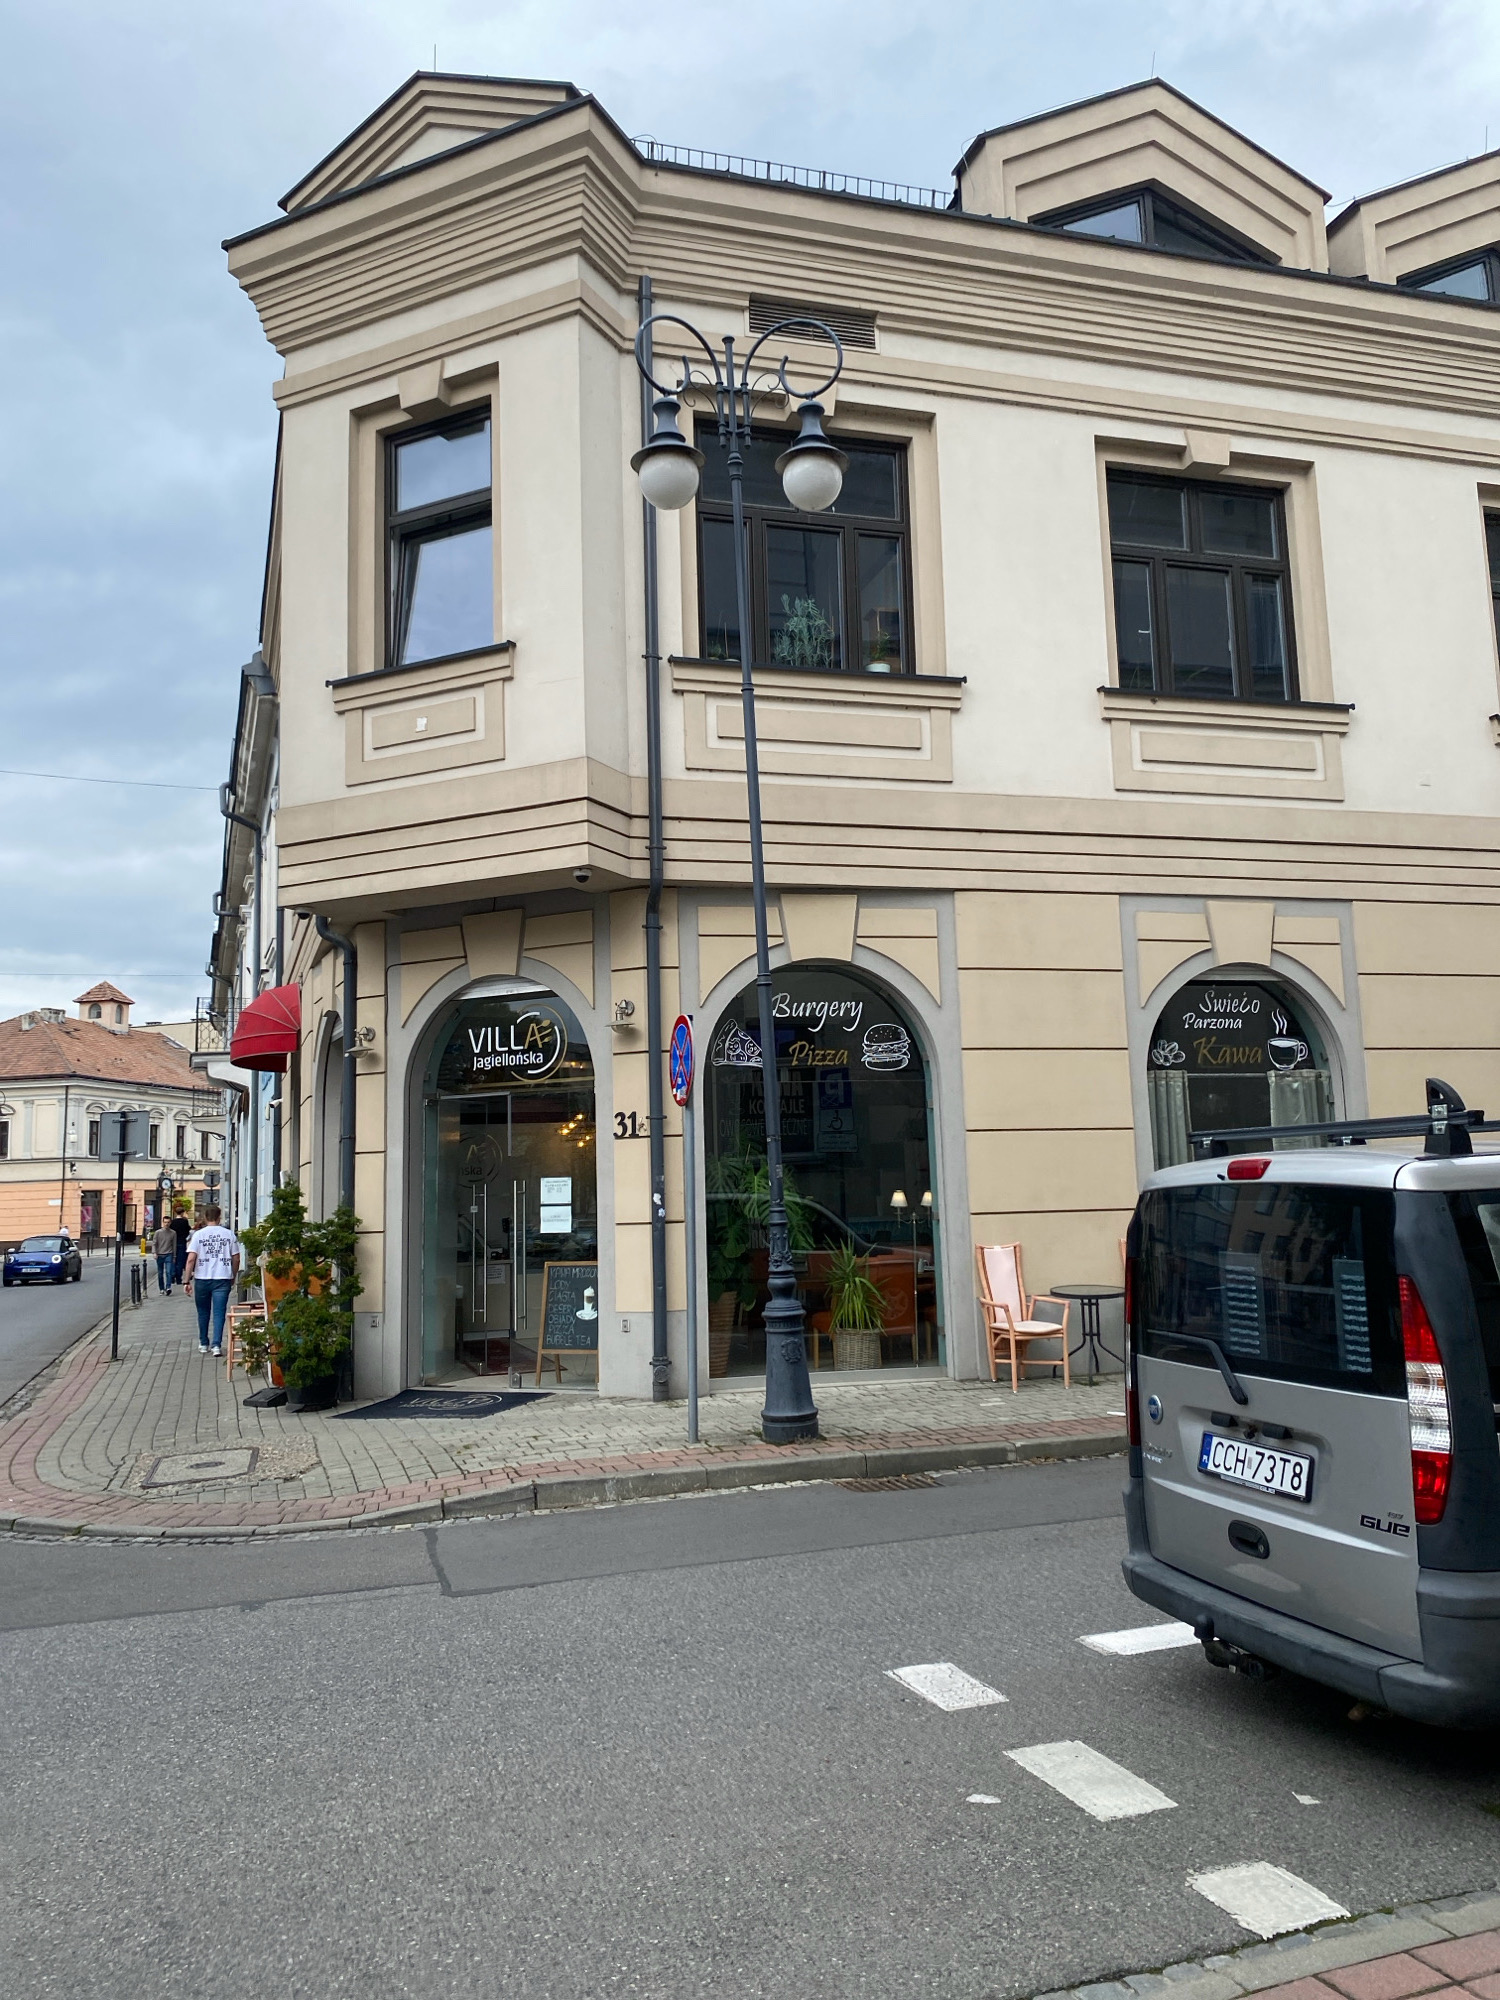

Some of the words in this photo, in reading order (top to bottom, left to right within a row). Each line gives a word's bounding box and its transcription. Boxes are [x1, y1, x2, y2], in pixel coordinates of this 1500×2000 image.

[772, 992, 863, 1032] Burgery
[1182, 1012, 1243, 1030] Parzona
[468, 1023, 546, 1054] VILLA
[1193, 1036, 1263, 1065] Kawa
[473, 1050, 544, 1071] Jagiellońska
[789, 1041, 849, 1066] Pizza
[749, 1098, 806, 1115] KOAJLE
[1212, 1441, 1248, 1477] CCH
[1251, 1450, 1304, 1491] 73T8
